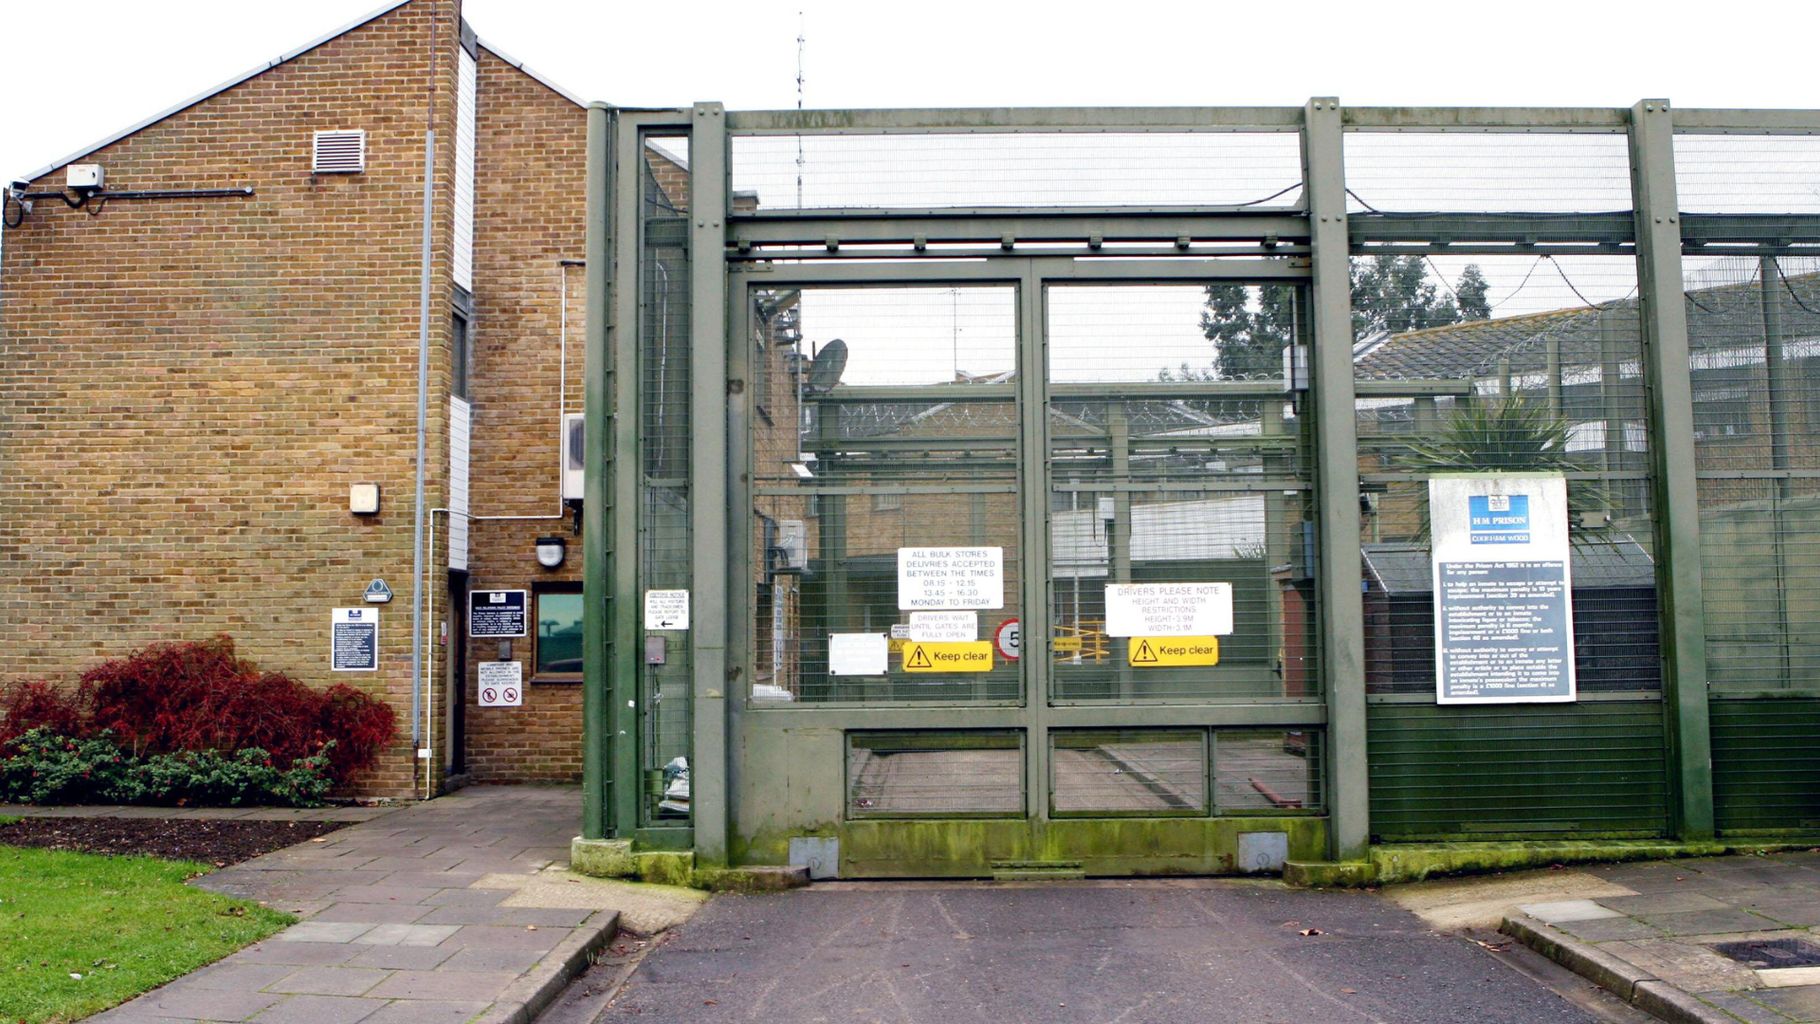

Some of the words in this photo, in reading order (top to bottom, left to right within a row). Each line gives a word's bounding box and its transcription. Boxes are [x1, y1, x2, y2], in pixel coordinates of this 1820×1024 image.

[1009, 632, 1019, 648] 5
[1160, 646, 1186, 656] Keep
[1189, 646, 1214, 654] clear
[934, 652, 960, 661] Keep
[963, 652, 988, 660] clear
